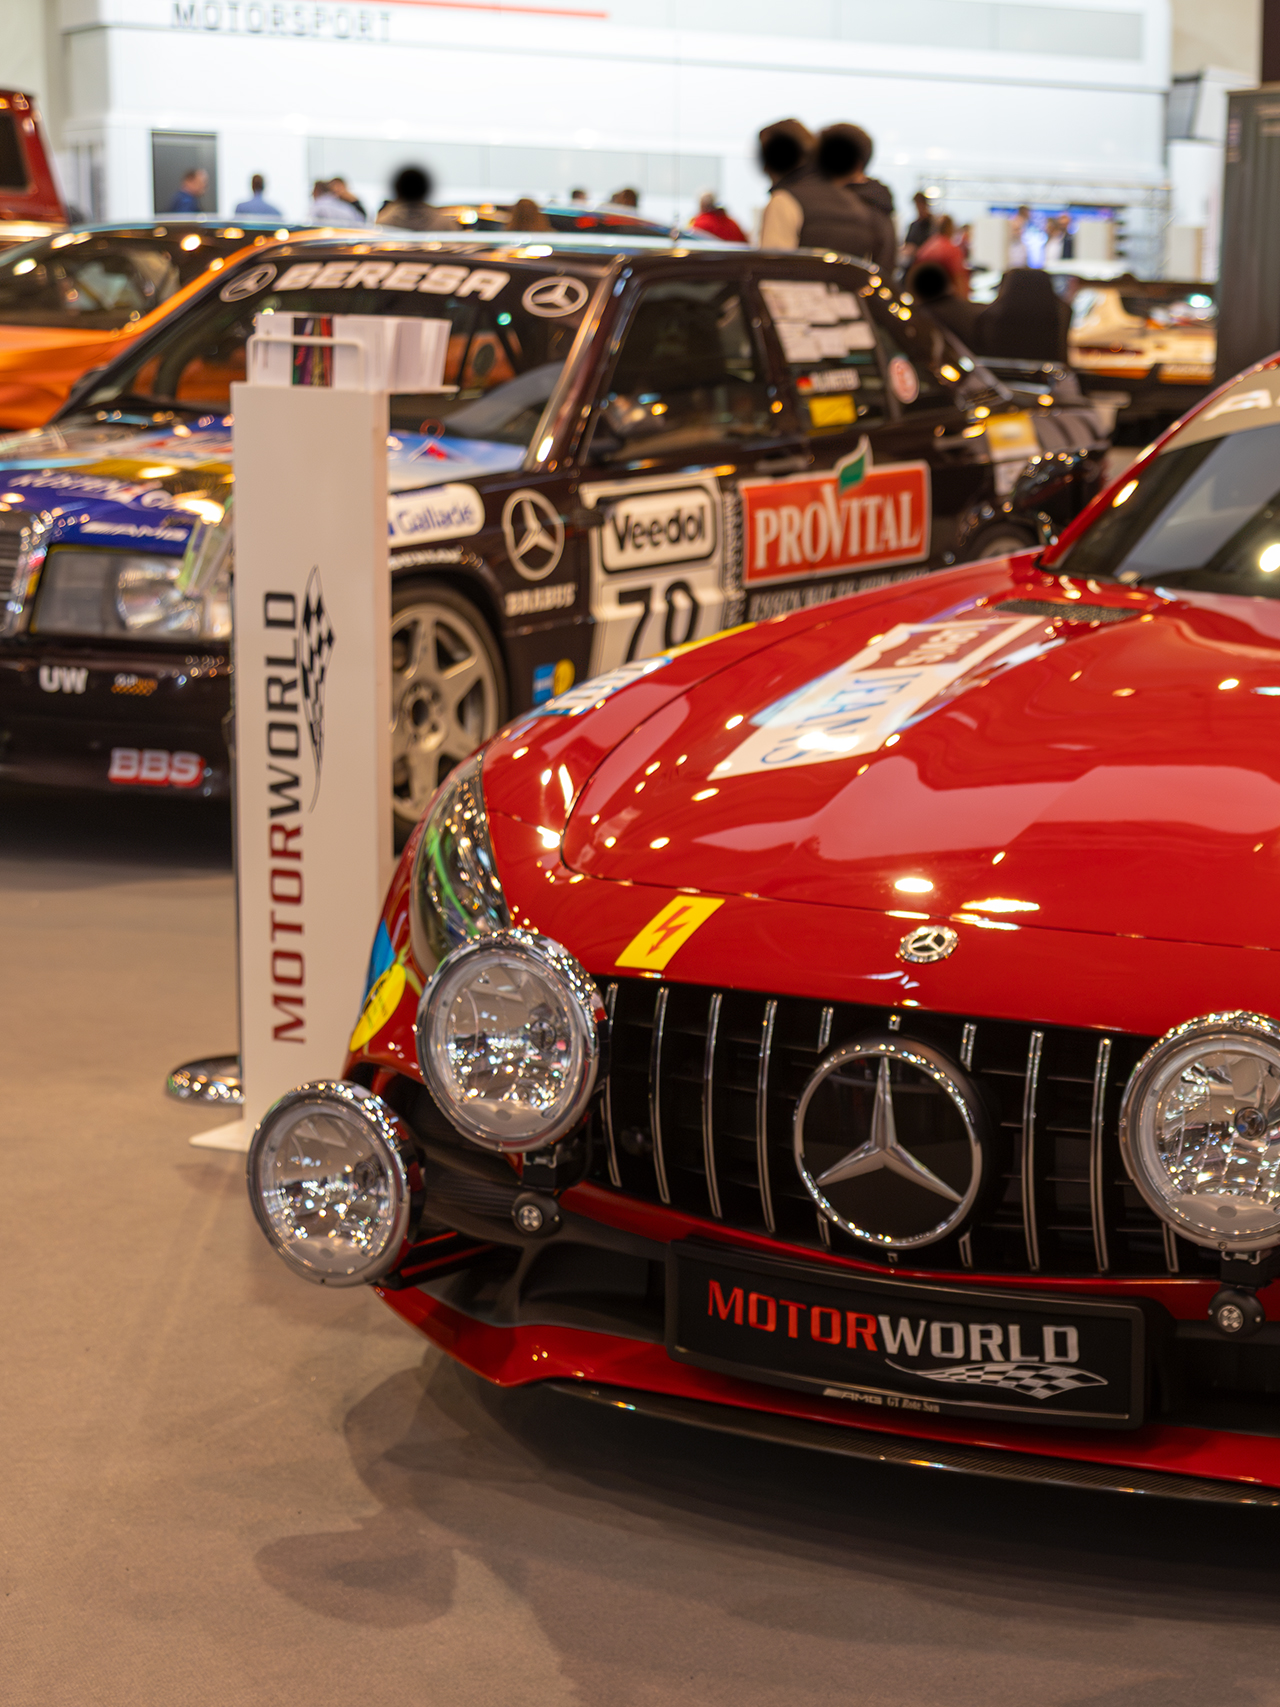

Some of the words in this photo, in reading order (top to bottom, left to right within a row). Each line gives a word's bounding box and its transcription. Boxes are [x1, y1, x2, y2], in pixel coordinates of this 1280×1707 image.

[172, 2, 391, 42] MOTORSPORT
[272, 260, 511, 301] BERESA
[612, 505, 706, 552] Veedol
[755, 484, 921, 569] PROVITAL
[617, 580, 700, 664] 70
[39, 665, 89, 694] UW
[760, 671, 924, 764] JEANS
[108, 748, 204, 787] BBS
[263, 590, 306, 1044] MOTORWORLD
[707, 1279, 1080, 1364] MOTORWORLD
[841, 1391, 882, 1406] AMG
[886, 1396, 900, 1408] GT
